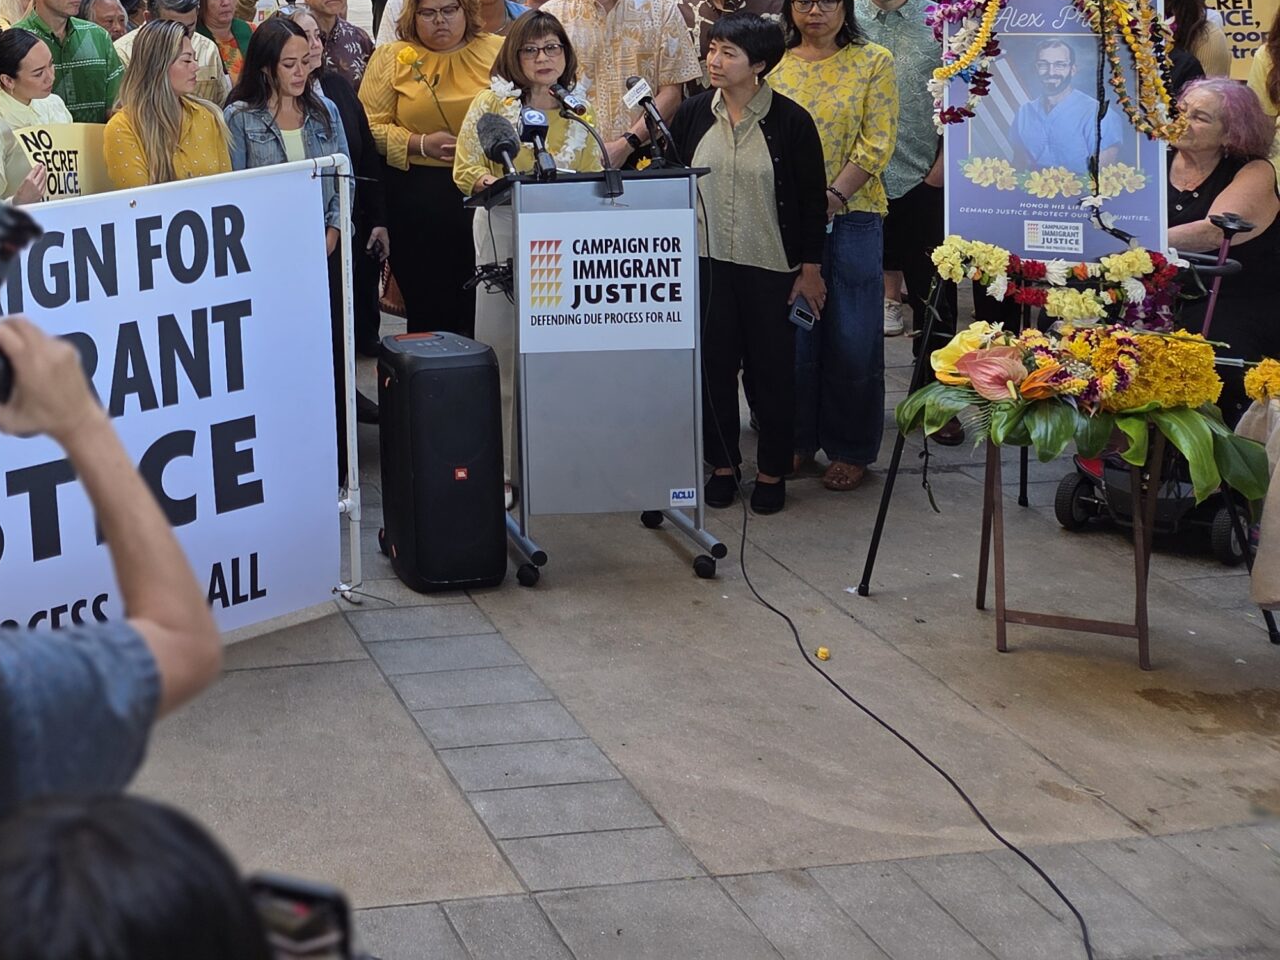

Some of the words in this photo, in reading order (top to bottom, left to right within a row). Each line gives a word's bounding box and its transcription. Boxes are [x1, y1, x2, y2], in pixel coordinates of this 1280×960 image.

[992, 6, 1045, 32] Alex
[1221, 10, 1260, 28] ICE,
[20, 130, 52, 152] NO
[32, 150, 78, 172] SECRET
[47, 173, 81, 197] OLICE,
[1041, 237, 1080, 245] JUSTICE
[1042, 230, 1080, 238] IMMIGRANT
[136, 204, 251, 292] FOR
[572, 238, 648, 254] CAMPAIGN
[653, 237, 681, 252] FOR
[573, 258, 682, 280] IMMIGRANT
[571, 283, 682, 310] JUSTICE
[531, 314, 582, 326] DEFENDING
[584, 313, 602, 324] DUE
[605, 312, 643, 324] PROCESS
[646, 312, 663, 323] FOR
[666, 311, 682, 323] ALL
[672, 491, 694, 499] ACLU
[208, 552, 266, 608] ALL
